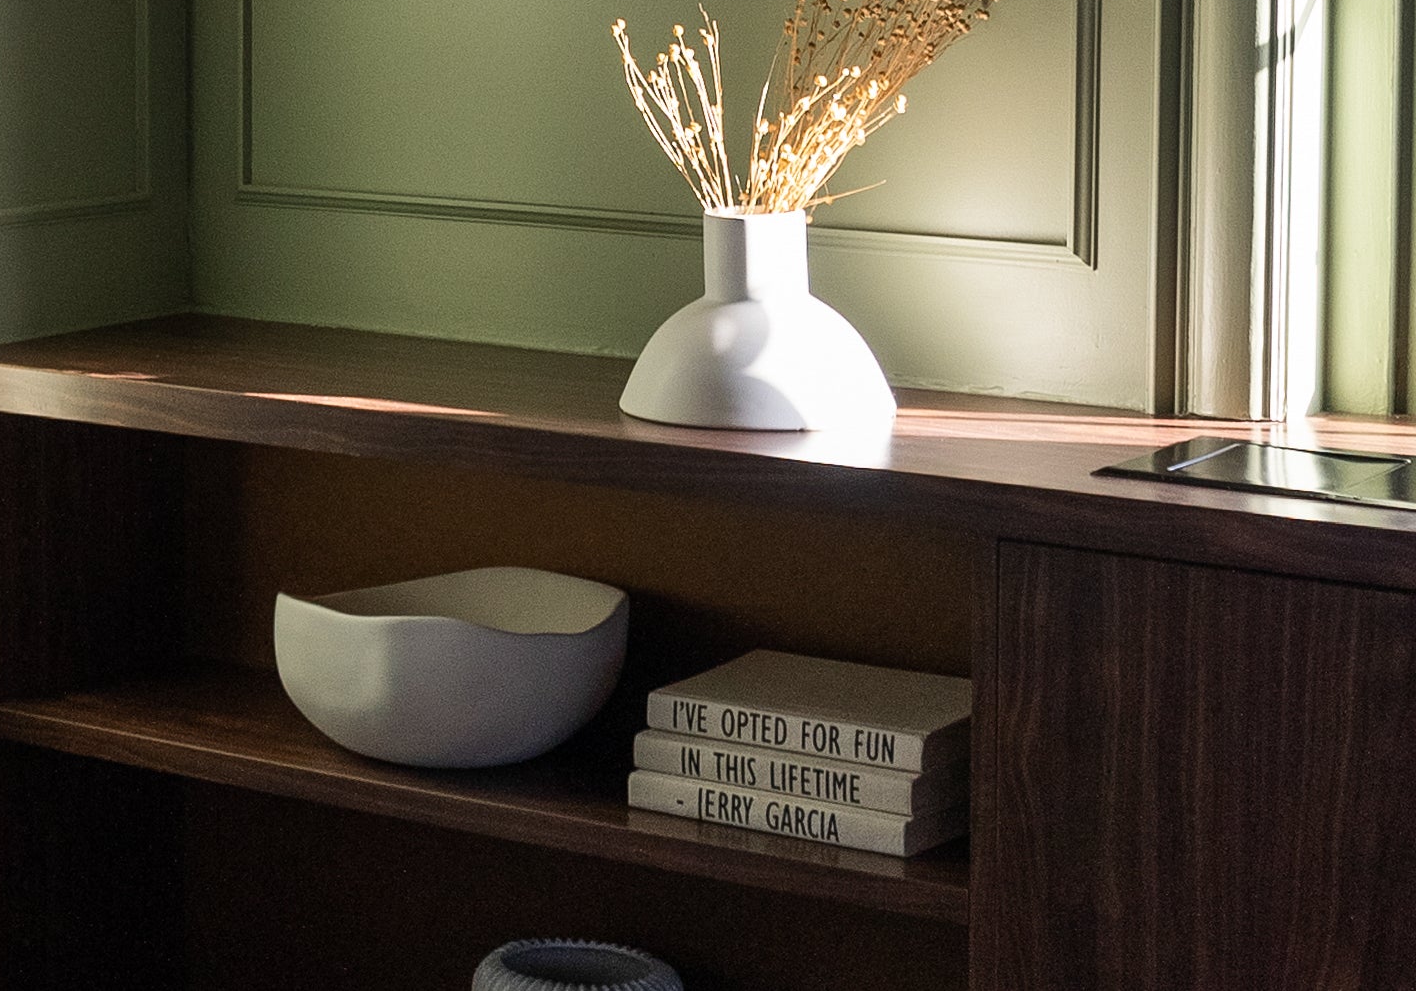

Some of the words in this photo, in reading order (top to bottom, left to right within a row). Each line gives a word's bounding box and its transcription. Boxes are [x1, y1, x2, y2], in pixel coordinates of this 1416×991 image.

[672, 700, 708, 734] I'VE
[721, 708, 787, 745] OPTED
[801, 721, 841, 756] FOR
[854, 729, 895, 764] FUN
[680, 746, 701, 776] IN
[714, 752, 757, 786] THIS
[769, 761, 861, 804] LIFETIME
[697, 787, 753, 826] JERRY
[766, 801, 840, 842] GARCIA
